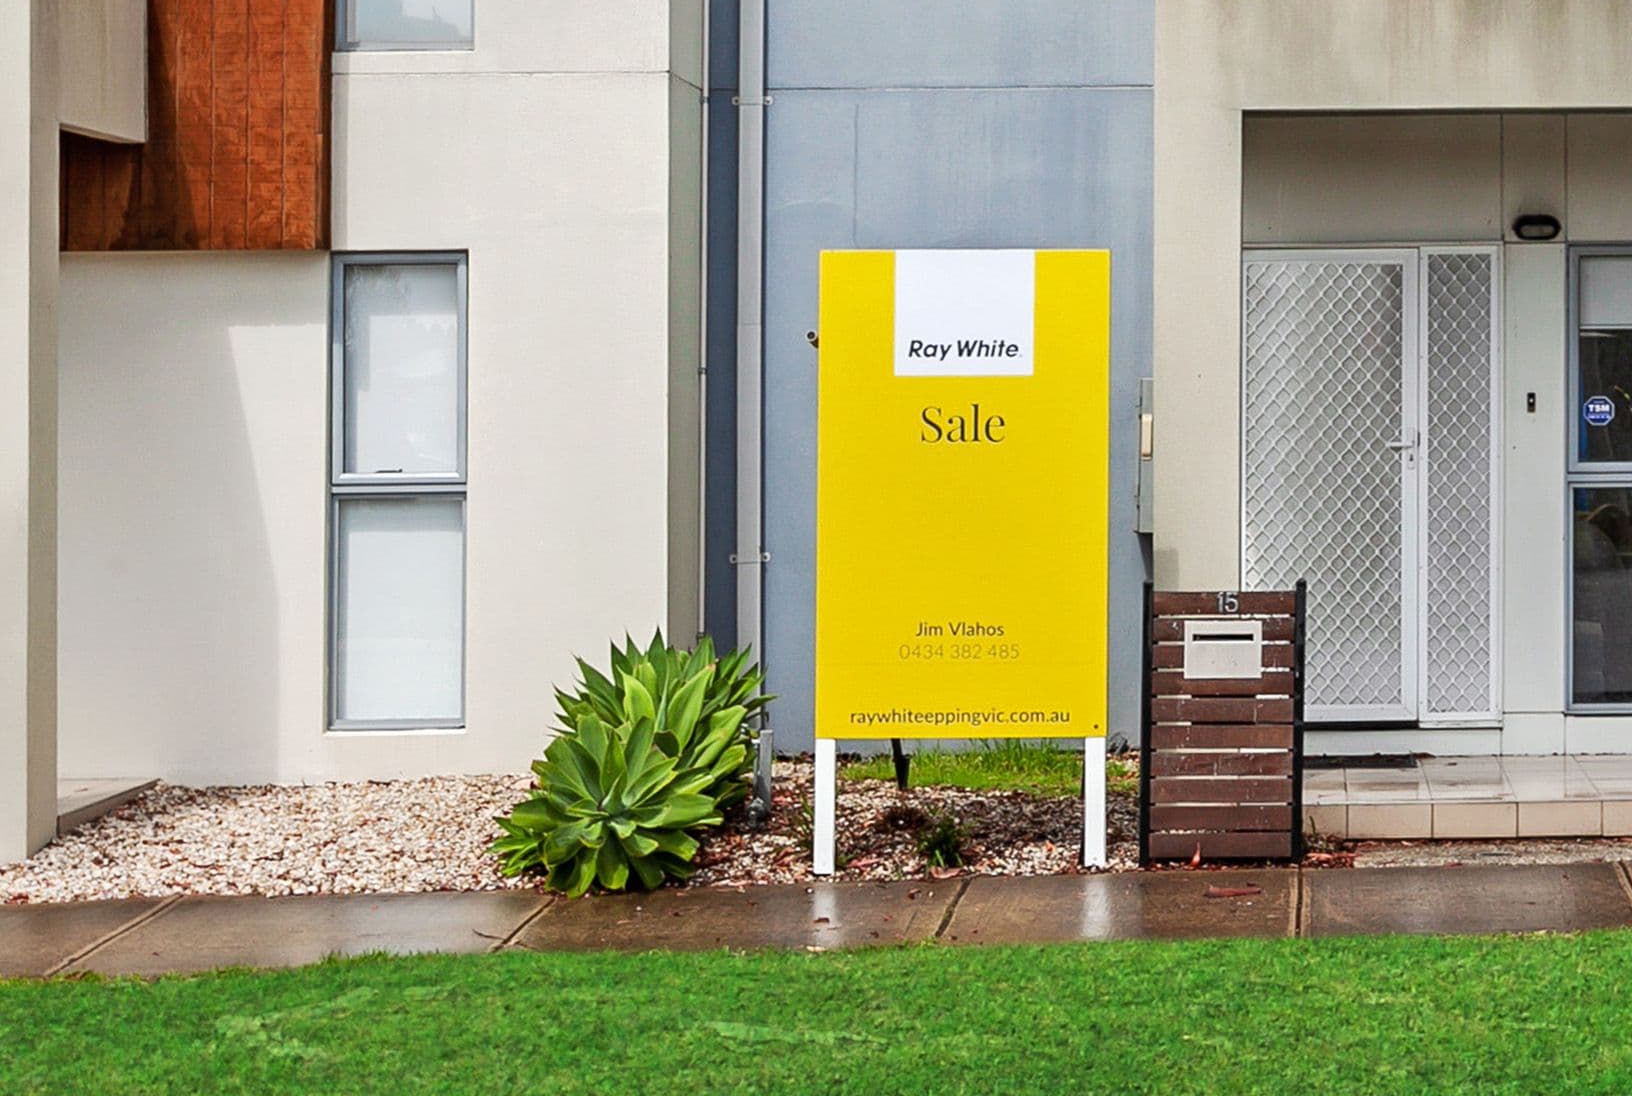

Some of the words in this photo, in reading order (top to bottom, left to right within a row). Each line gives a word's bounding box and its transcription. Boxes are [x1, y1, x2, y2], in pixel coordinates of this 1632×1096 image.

[909, 340, 951, 361] Ray
[957, 340, 1019, 357] White
[920, 404, 1006, 443] Sale
[1217, 591, 1239, 613] 15
[916, 622, 943, 637] Jim
[949, 622, 1004, 637] Vlahos
[899, 644, 943, 659] 0434
[951, 644, 981, 659] 382
[988, 644, 1020, 659] 485
[850, 708, 1070, 726] raywhiteeppingvic.com.au
